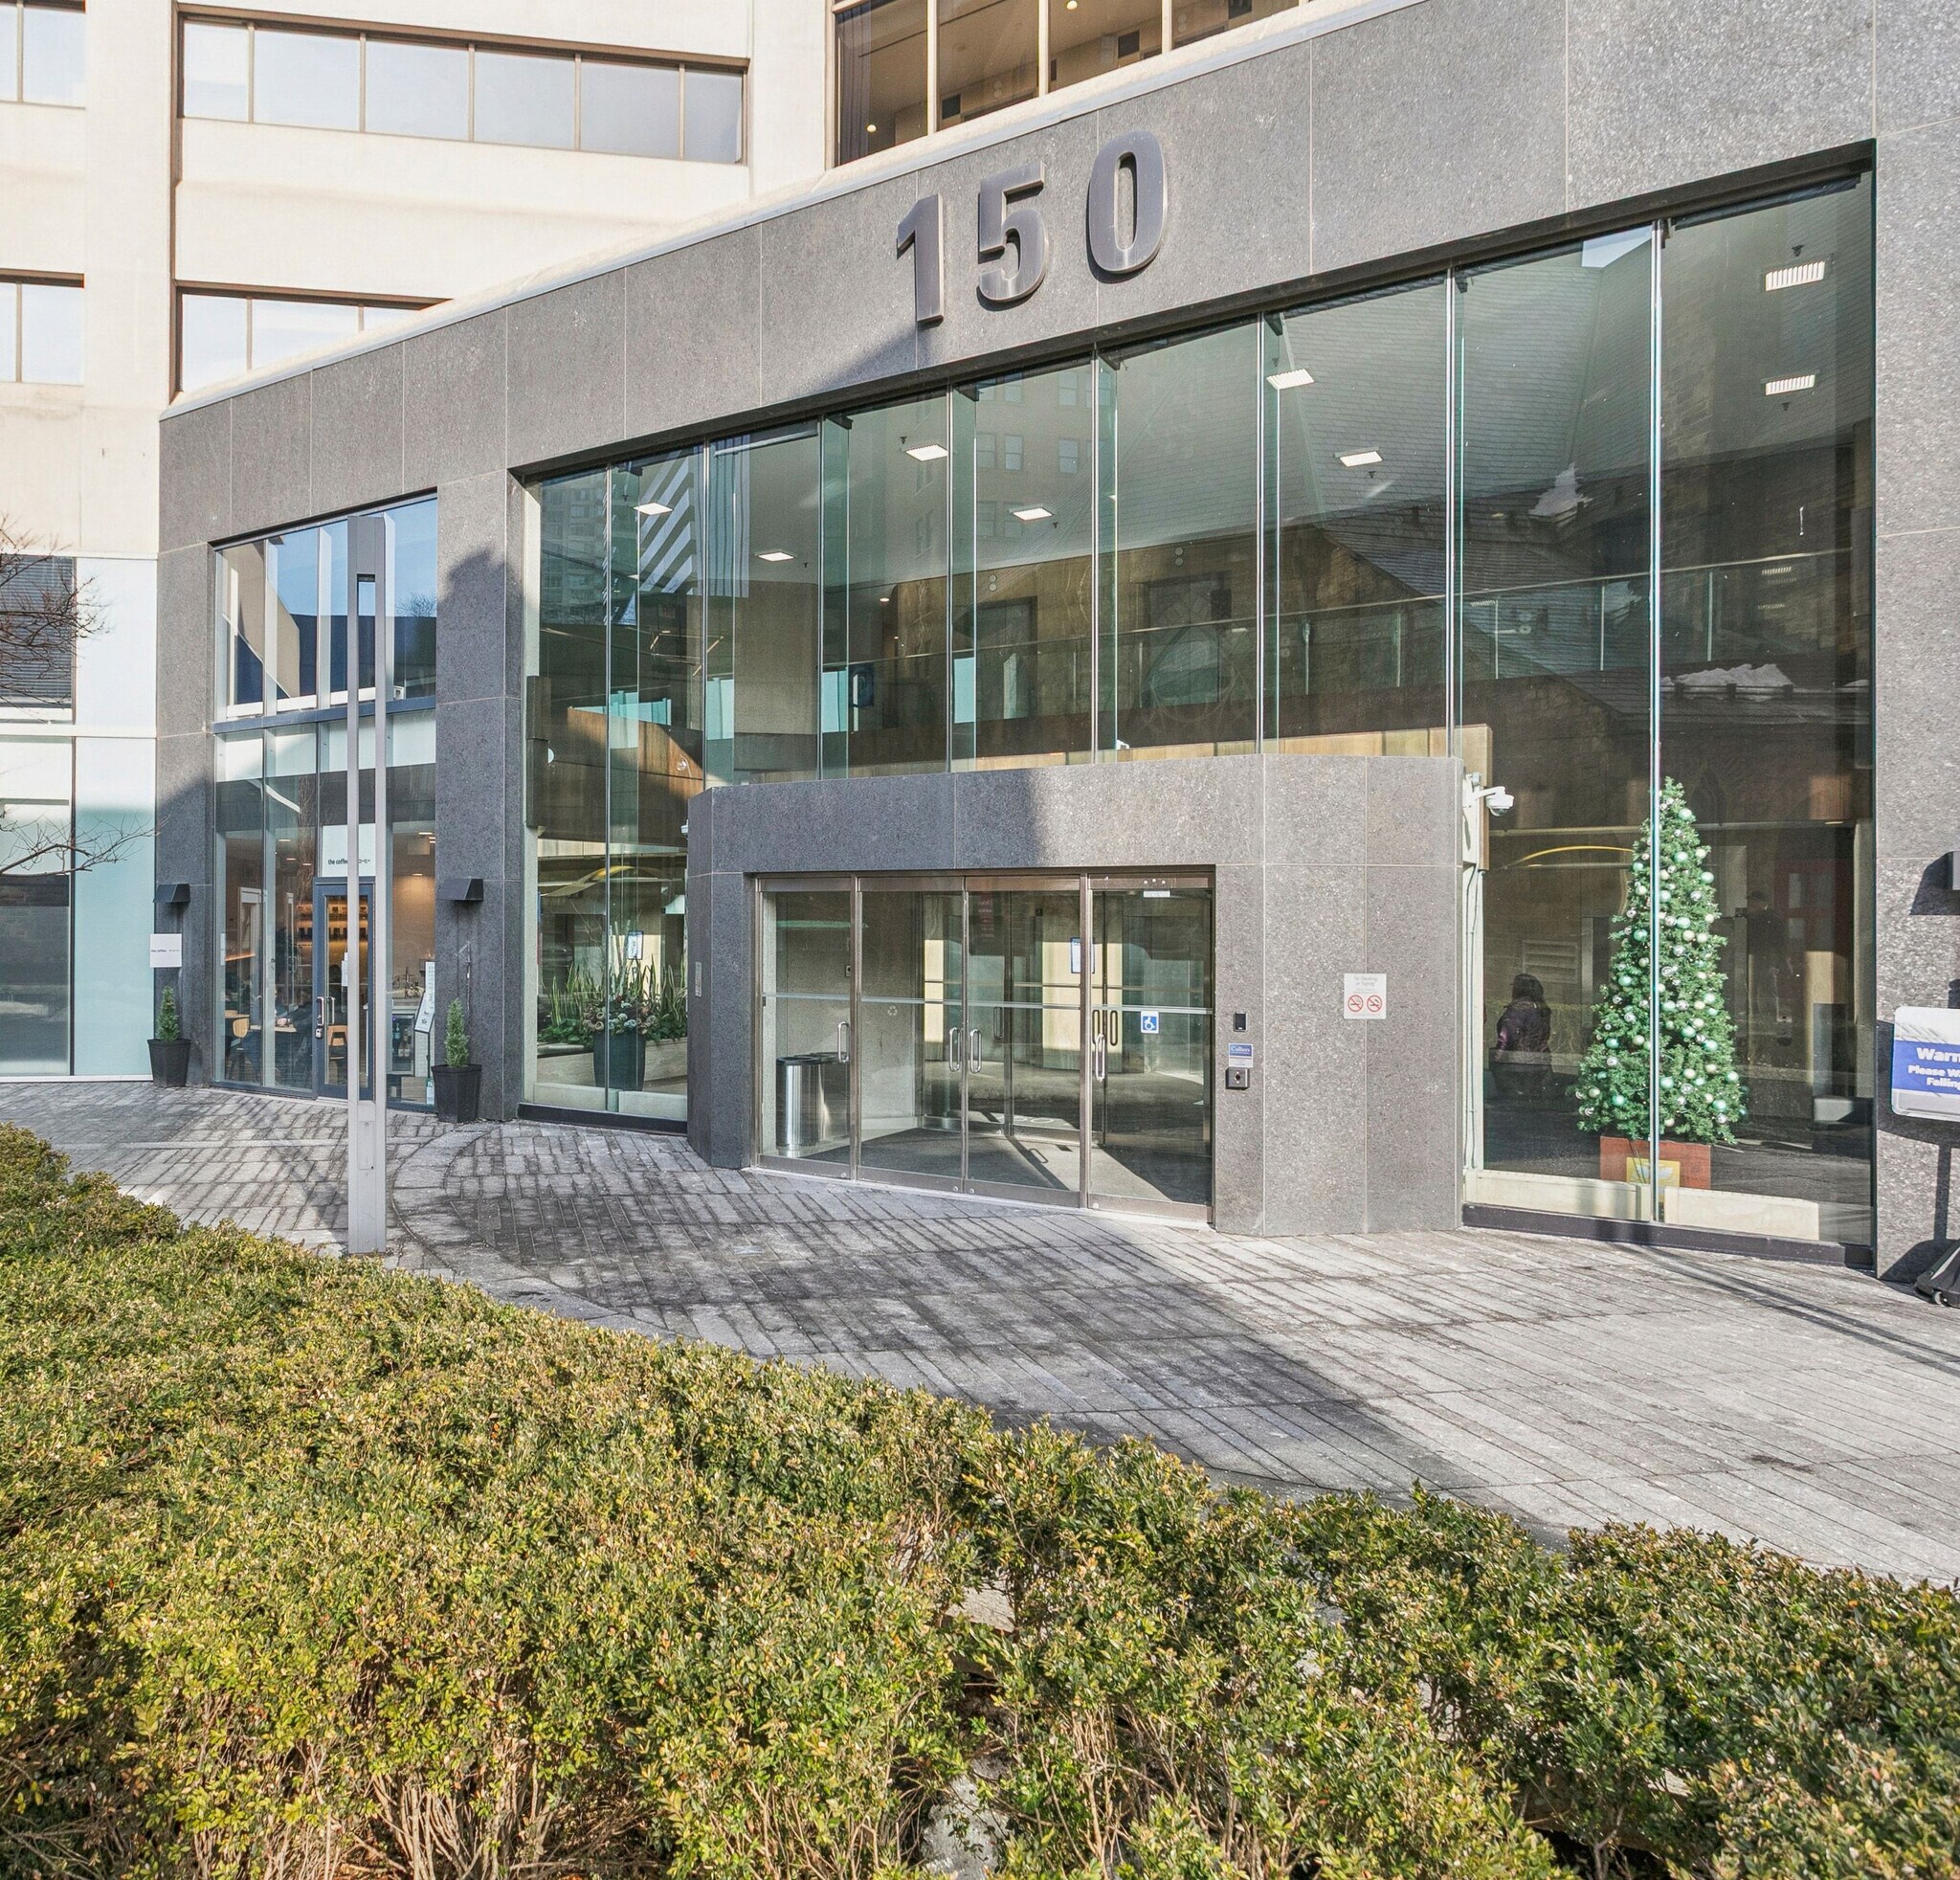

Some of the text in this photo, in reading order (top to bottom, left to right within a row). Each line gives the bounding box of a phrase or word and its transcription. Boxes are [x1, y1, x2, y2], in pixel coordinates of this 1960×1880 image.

[896, 130, 1169, 325] 150
[1907, 1064, 1960, 1078] Please W
